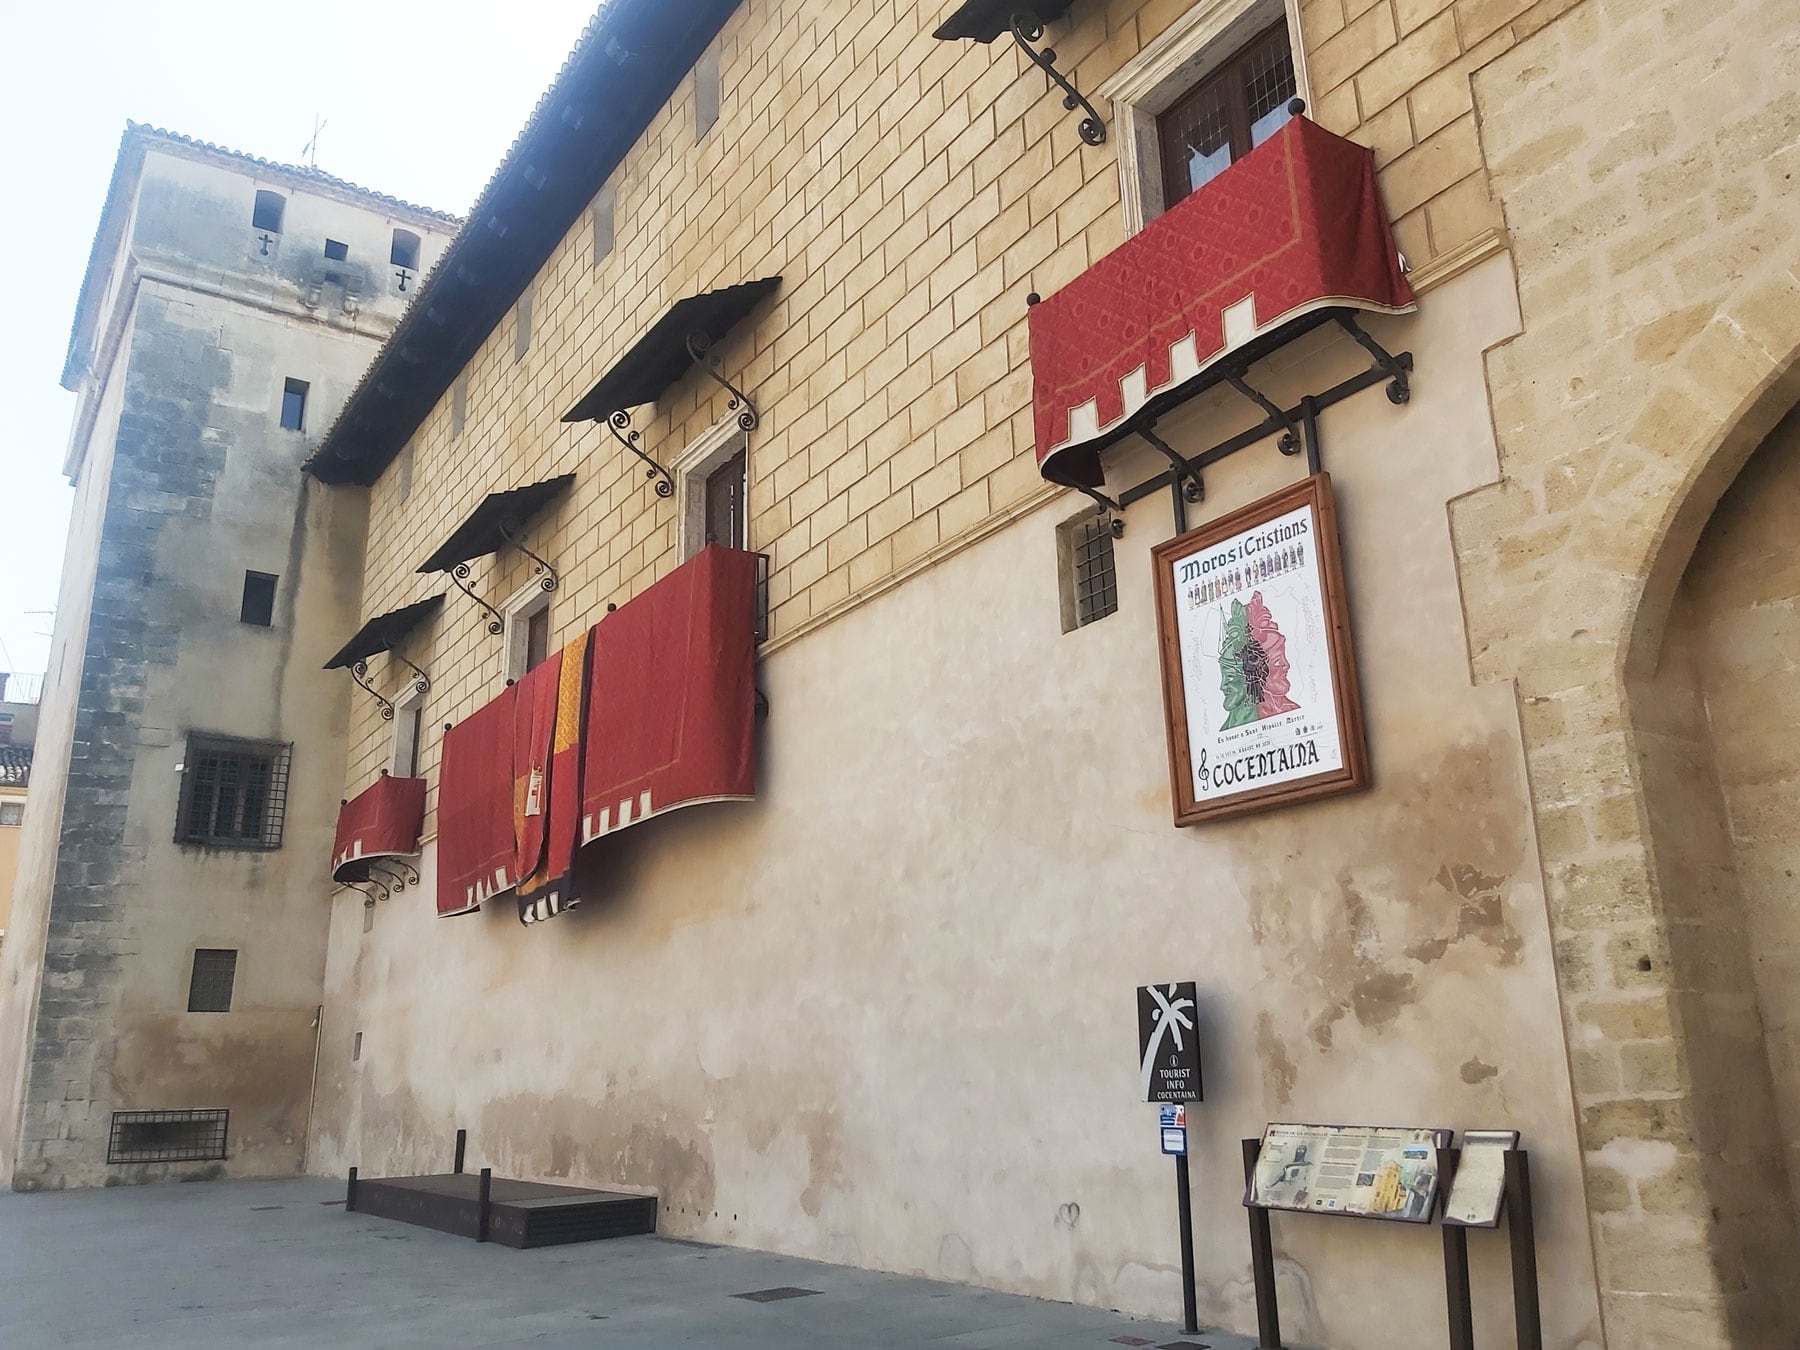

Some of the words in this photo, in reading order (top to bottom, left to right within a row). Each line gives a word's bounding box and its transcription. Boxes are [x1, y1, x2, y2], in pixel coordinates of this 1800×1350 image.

[1180, 548, 1236, 584] Moros
[1238, 541, 1243, 559] i
[1244, 518, 1308, 556] Cristians
[1213, 739, 1320, 788] COCENTAINA
[1160, 1069, 1190, 1078] TOURIST
[1166, 1080, 1185, 1090] INFO
[1157, 1091, 1196, 1099] COCENTAINA
